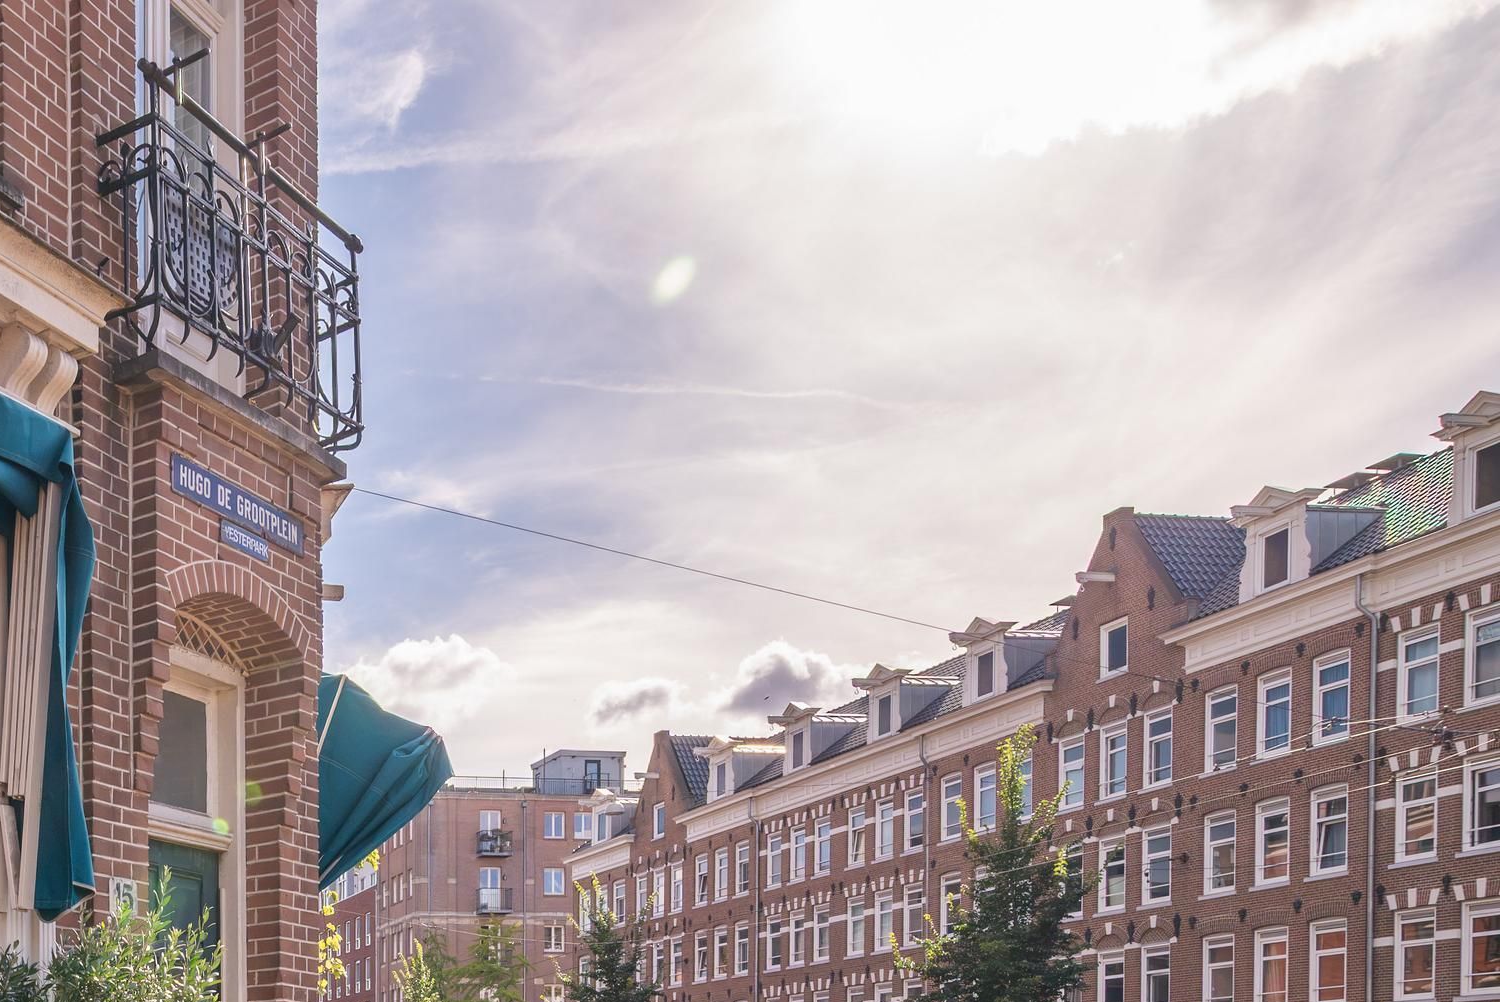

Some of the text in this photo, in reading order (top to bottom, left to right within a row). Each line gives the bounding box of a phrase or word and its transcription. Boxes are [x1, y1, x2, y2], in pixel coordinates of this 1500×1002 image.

[180, 465, 297, 545] HUGO DE GROOTPLEIN
